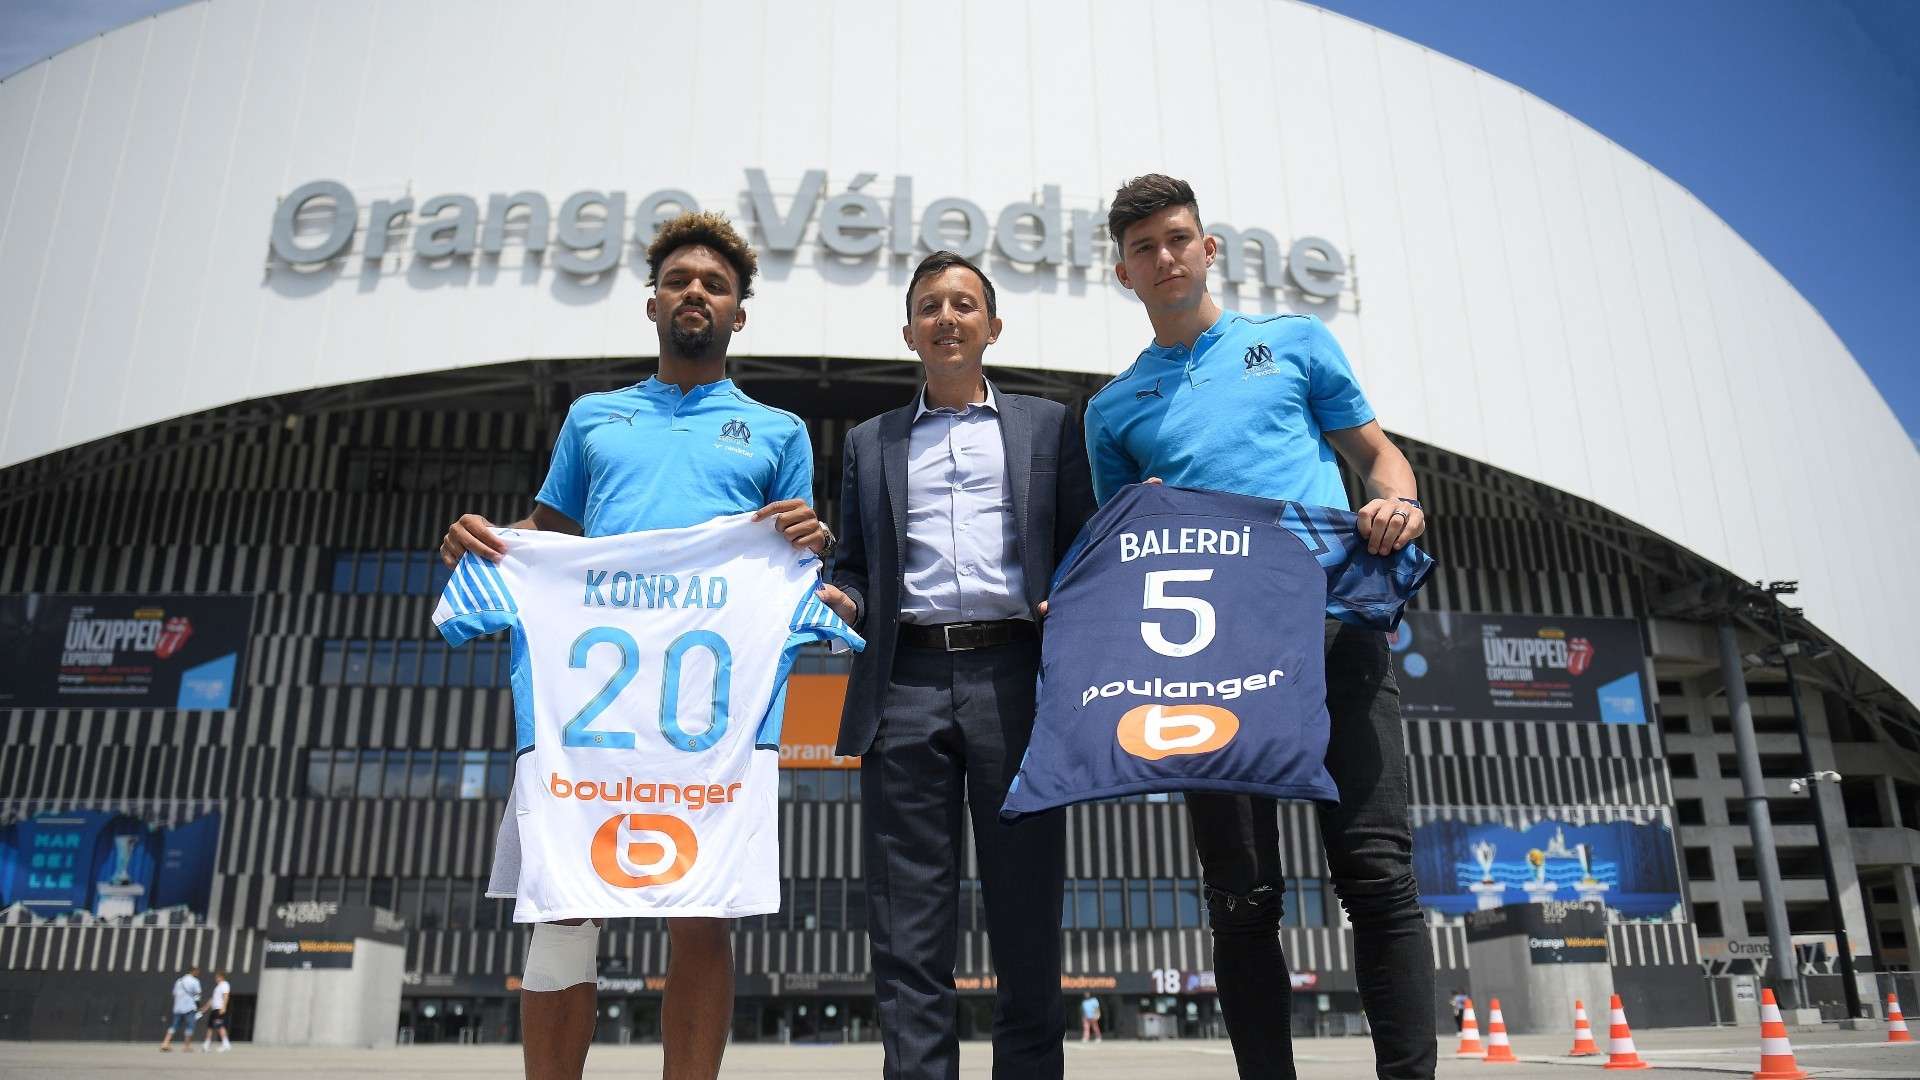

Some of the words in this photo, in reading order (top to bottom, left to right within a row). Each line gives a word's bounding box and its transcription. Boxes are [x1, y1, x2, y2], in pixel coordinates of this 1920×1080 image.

[744, 168, 1347, 299] Vélodrme
[583, 569, 729, 609] KONRAD
[1140, 568, 1216, 658] 5
[65, 619, 163, 651] UNZIPPED
[1482, 637, 1568, 668] UNZIPPED
[562, 626, 733, 752] 20
[1082, 669, 1285, 707] boulanger
[779, 744, 846, 766] orang
[550, 772, 742, 811] boulanger
[1728, 940, 1771, 957] Orang
[1151, 968, 1181, 994] 18
